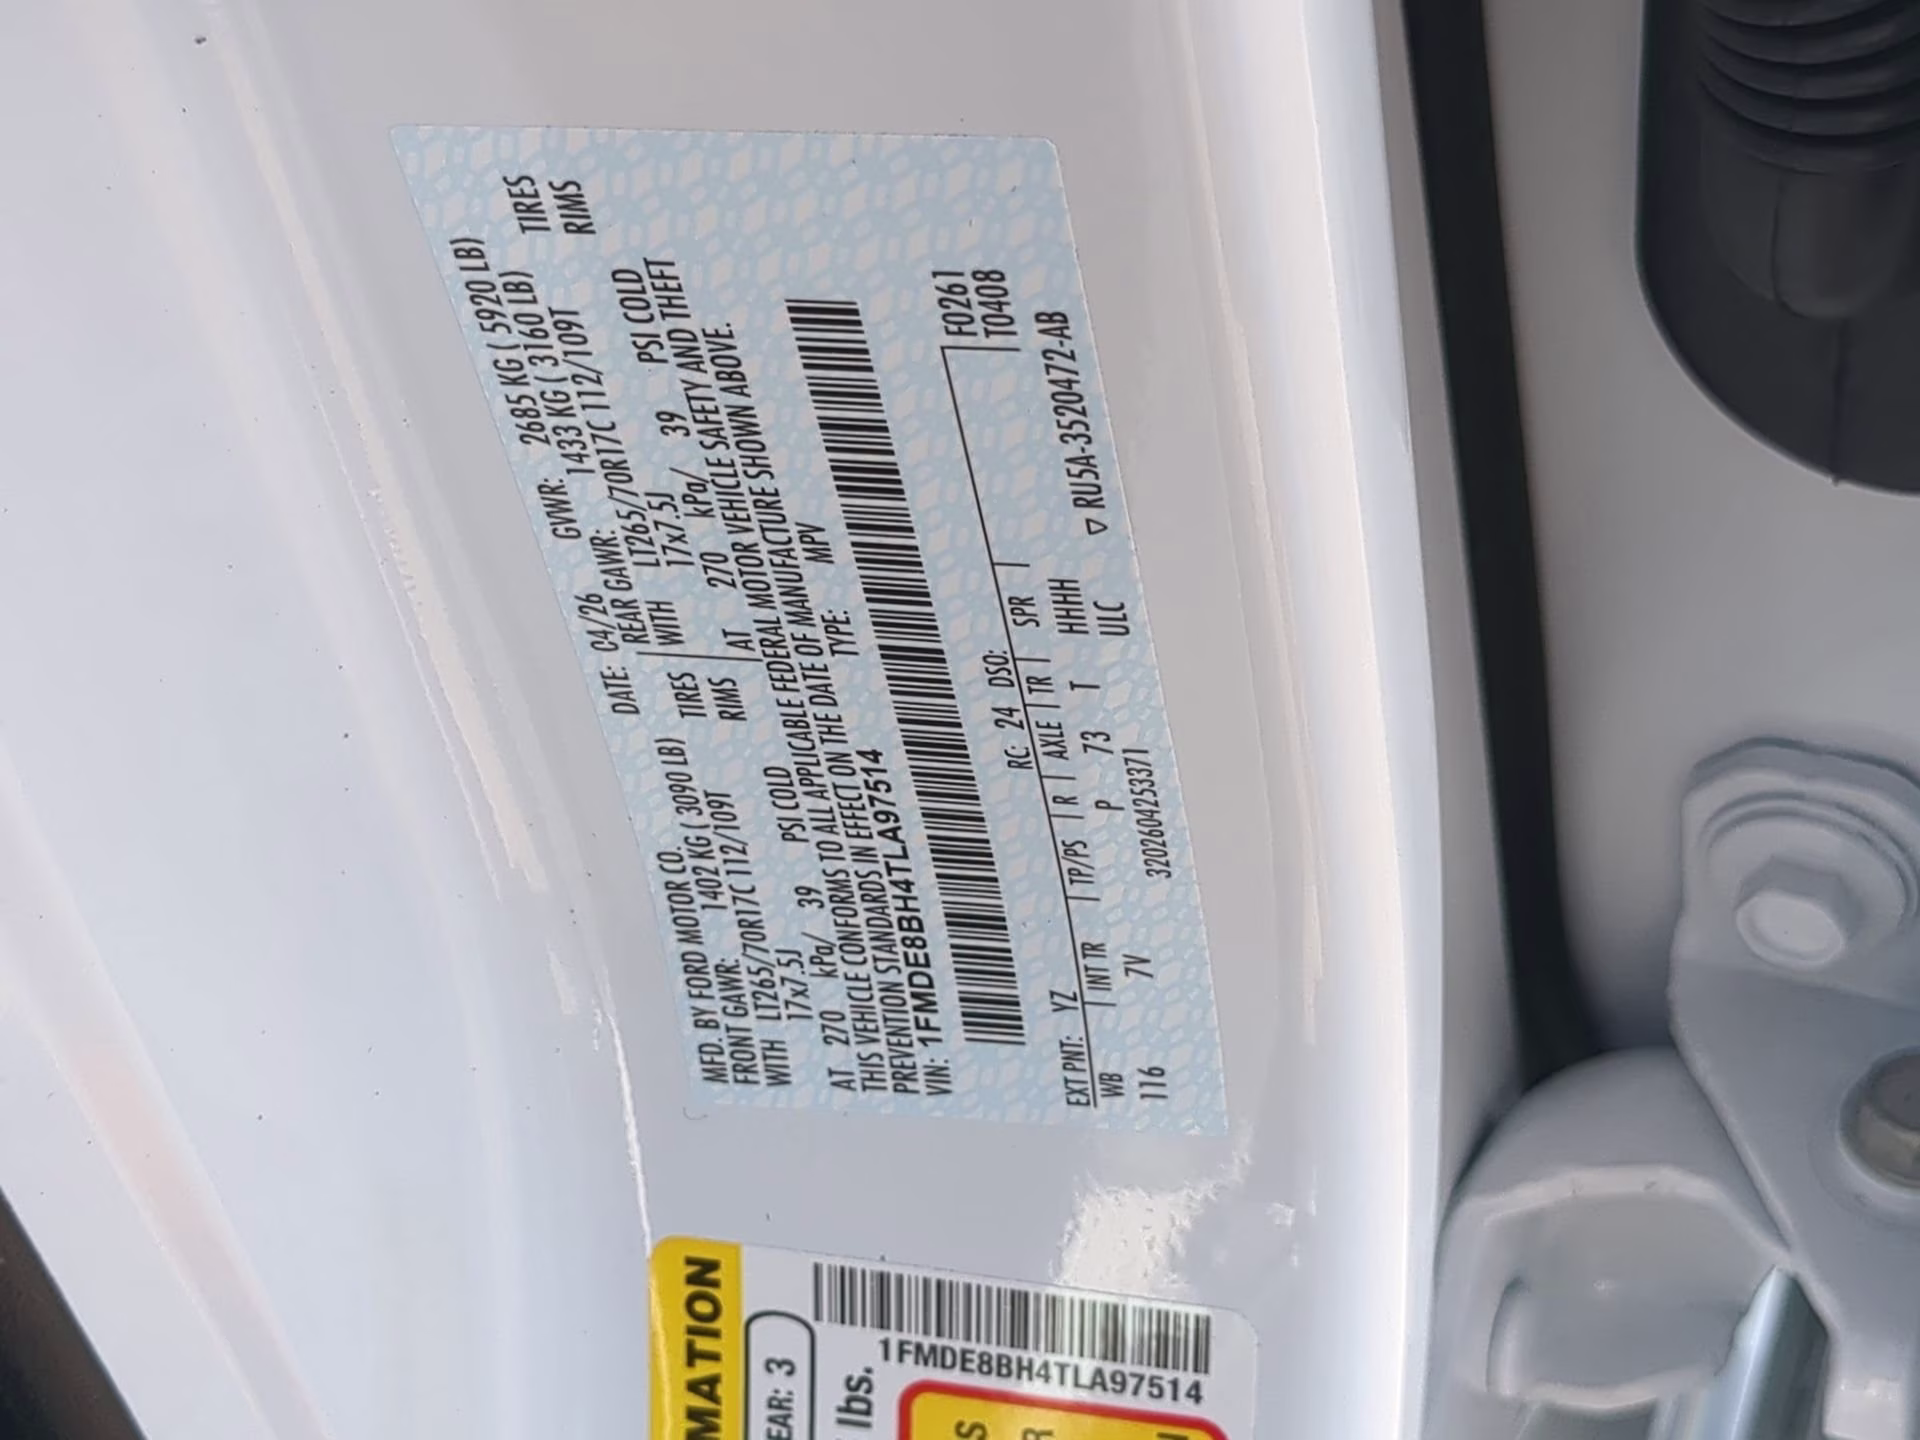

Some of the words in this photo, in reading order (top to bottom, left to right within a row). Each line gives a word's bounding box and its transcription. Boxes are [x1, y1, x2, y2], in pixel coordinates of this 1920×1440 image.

[503, 175, 551, 234] TIRES
[548, 180, 596, 235] RIMS
[449, 238, 490, 272] LB)
[465, 280, 512, 334] 5920
[498, 270, 538, 304] LB)
[611, 269, 654, 324] COLD
[643, 257, 691, 320] THEFT
[512, 313, 559, 367] 3160
[548, 307, 611, 411] 112/109T
[630, 333, 668, 364] PSI
[666, 328, 707, 373] AND
[701, 323, 751, 398] ABOVE.
[492, 359, 531, 386] KG
[505, 395, 550, 446] 2685
[539, 391, 577, 418] KG
[656, 412, 690, 437] 39
[679, 380, 730, 450] SAFETY
[1034, 312, 1106, 509] RU5A-3520472-AB
[551, 426, 595, 475] 1433
[724, 405, 774, 480] SHOWN
[537, 478, 582, 539] GVWR:
[585, 421, 661, 568] LT265/70R17C
[669, 467, 716, 518] kPa/
[705, 458, 754, 535] VEHICLE
[644, 492, 695, 567] 17x7.5J
[795, 522, 834, 564] MPV
[589, 530, 633, 591] GAWR:
[700, 552, 737, 589] 270
[734, 542, 776, 610] MOTOR
[756, 486, 817, 628] MANUFACTURE
[610, 599, 650, 644] REAR
[645, 601, 685, 646] WITH
[1008, 596, 1040, 628] SPR
[1047, 578, 1089, 634] HHHH
[1093, 601, 1130, 637] ULC
[723, 628, 755, 651] AT
[753, 617, 800, 692] FEDERAL
[791, 633, 825, 658] OF
[822, 610, 859, 657] TYPE:
[600, 666, 640, 715] DATE:
[799, 663, 839, 707] DATE
[983, 649, 1015, 688] DSO:
[1026, 676, 1052, 695] TR
[1069, 681, 1099, 691] T
[667, 672, 707, 718] TIRES
[708, 678, 747, 721] RIMS
[816, 713, 847, 744] THE
[991, 707, 1025, 730] 24
[1036, 721, 1069, 761] AXLE
[654, 737, 687, 765] LB)
[775, 698, 830, 801] APPLICABLE
[824, 752, 855, 776] ON
[1004, 746, 1033, 770] RC:
[1080, 731, 1114, 754] 73
[664, 771, 699, 815] 3090
[763, 766, 797, 810] COLD
[1052, 796, 1079, 805] R
[1095, 800, 1124, 811] P
[704, 789, 752, 876] 112/109T
[776, 817, 809, 843] PSI
[806, 806, 838, 836] ALL
[833, 782, 873, 840] EFFECT
[1122, 748, 1172, 879] 3202604253371
[656, 847, 686, 875] CO.
[684, 836, 714, 859] KG
[816, 840, 846, 863] TO
[847, 846, 877, 863] IN
[1062, 840, 1096, 885] TP/PS
[692, 865, 728, 911] 1402
[795, 886, 825, 909] 39
[856, 748, 943, 1048] 1FMDE8BH4TLA97514
[665, 881, 705, 945] MOTOR
[822, 869, 867, 965] CONFORMS
[858, 870, 904, 974] STANDARDS
[728, 884, 782, 1021] LT265/70R17C
[801, 932, 838, 979] kPa/
[1082, 942, 1106, 964] TR
[1123, 954, 1154, 979] 7V
[682, 952, 714, 999] FORD
[717, 957, 750, 1017] GAWR:
[775, 948, 813, 1021] 17x7.5J
[1085, 965, 1112, 992] INT
[691, 1006, 720, 1029] BY
[842, 972, 882, 1046] VEHICLE
[1049, 990, 1079, 1013] YZ
[821, 1010, 851, 1046] 270
[881, 982, 919, 1095] PREVENTION
[699, 1038, 729, 1084] MFD.
[725, 1026, 759, 1085] FRONT
[762, 1040, 792, 1087] WITH
[857, 1052, 888, 1092] THIS
[1058, 1037, 1086, 1072] PNT:
[827, 1068, 857, 1091] AT
[921, 1059, 953, 1096] VIN:
[1064, 1076, 1091, 1106] EXT
[1098, 1073, 1125, 1098] WB
[1139, 1067, 1168, 1101] 116
[683, 1255, 722, 1440] MATION
[764, 1358, 796, 1376] 3
[879, 1338, 1203, 1405] 1FMDE8BH4TLA97514
[836, 1366, 874, 1429] lbs.
